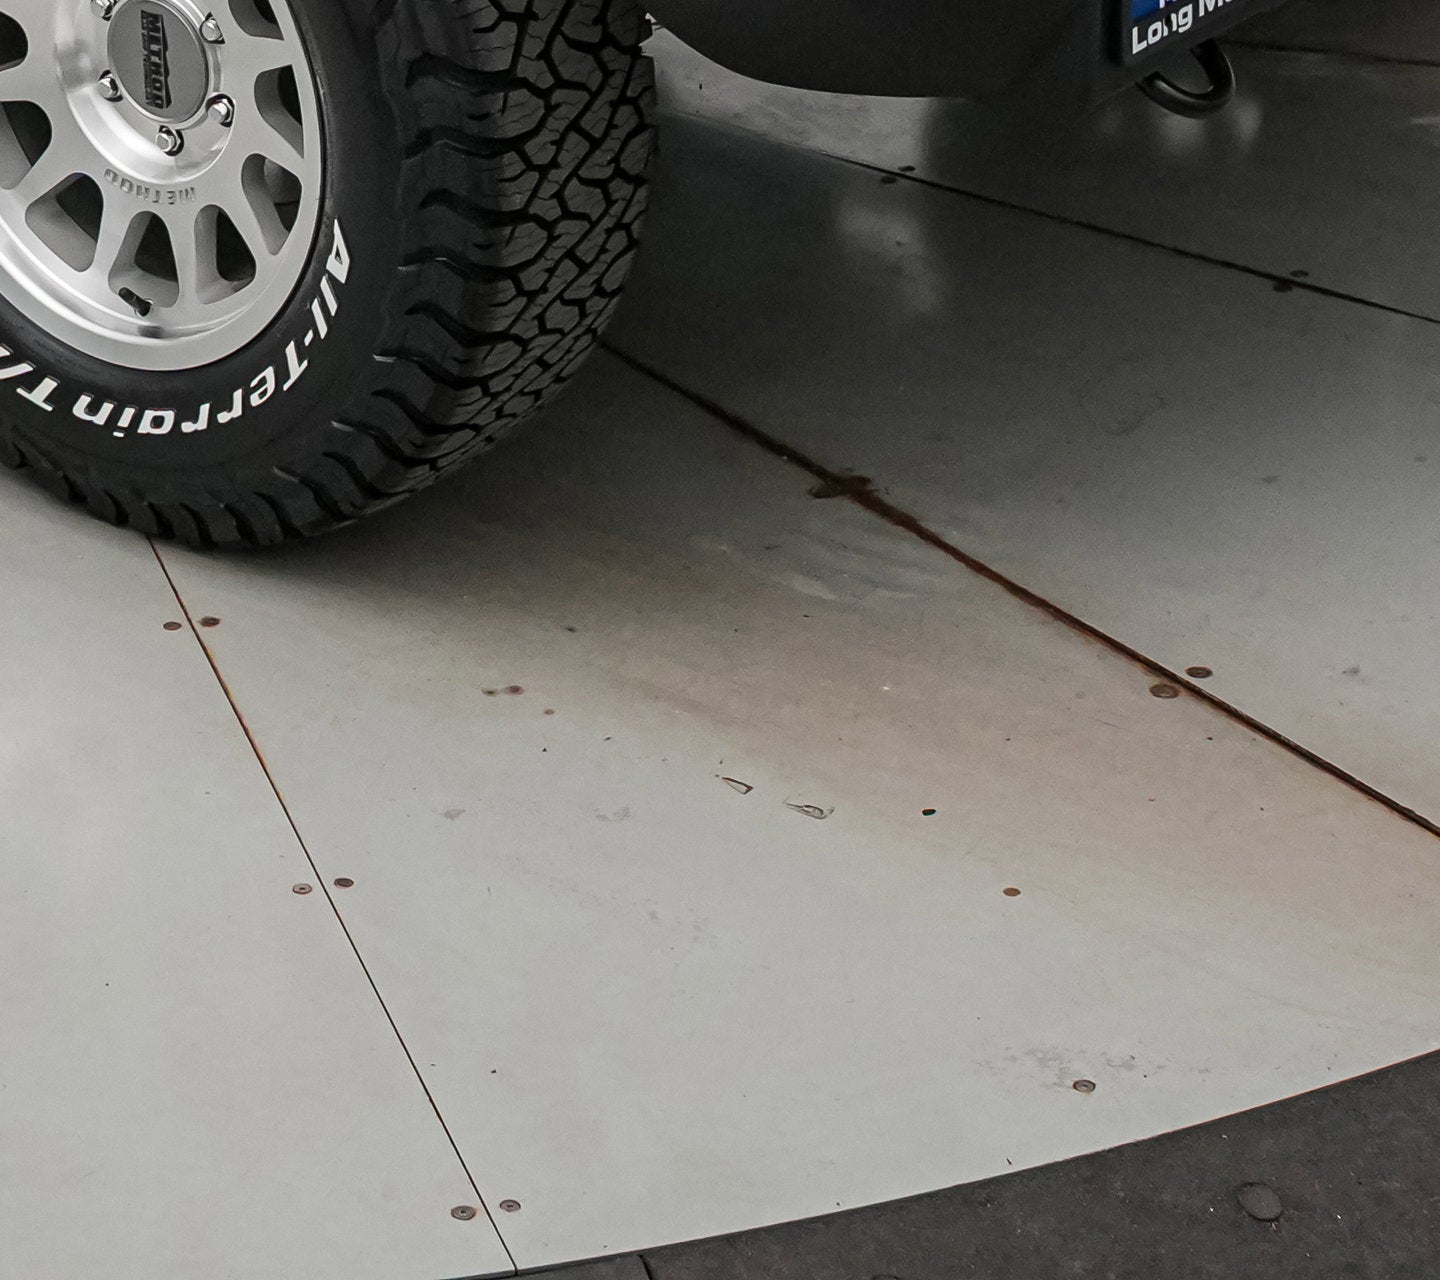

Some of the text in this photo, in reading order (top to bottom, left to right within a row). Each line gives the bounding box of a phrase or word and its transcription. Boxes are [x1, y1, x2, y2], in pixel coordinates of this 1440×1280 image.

[1131, 3, 1194, 55] Long
[103, 168, 195, 205] METHOD
[71, 218, 351, 438] All-Terrain
